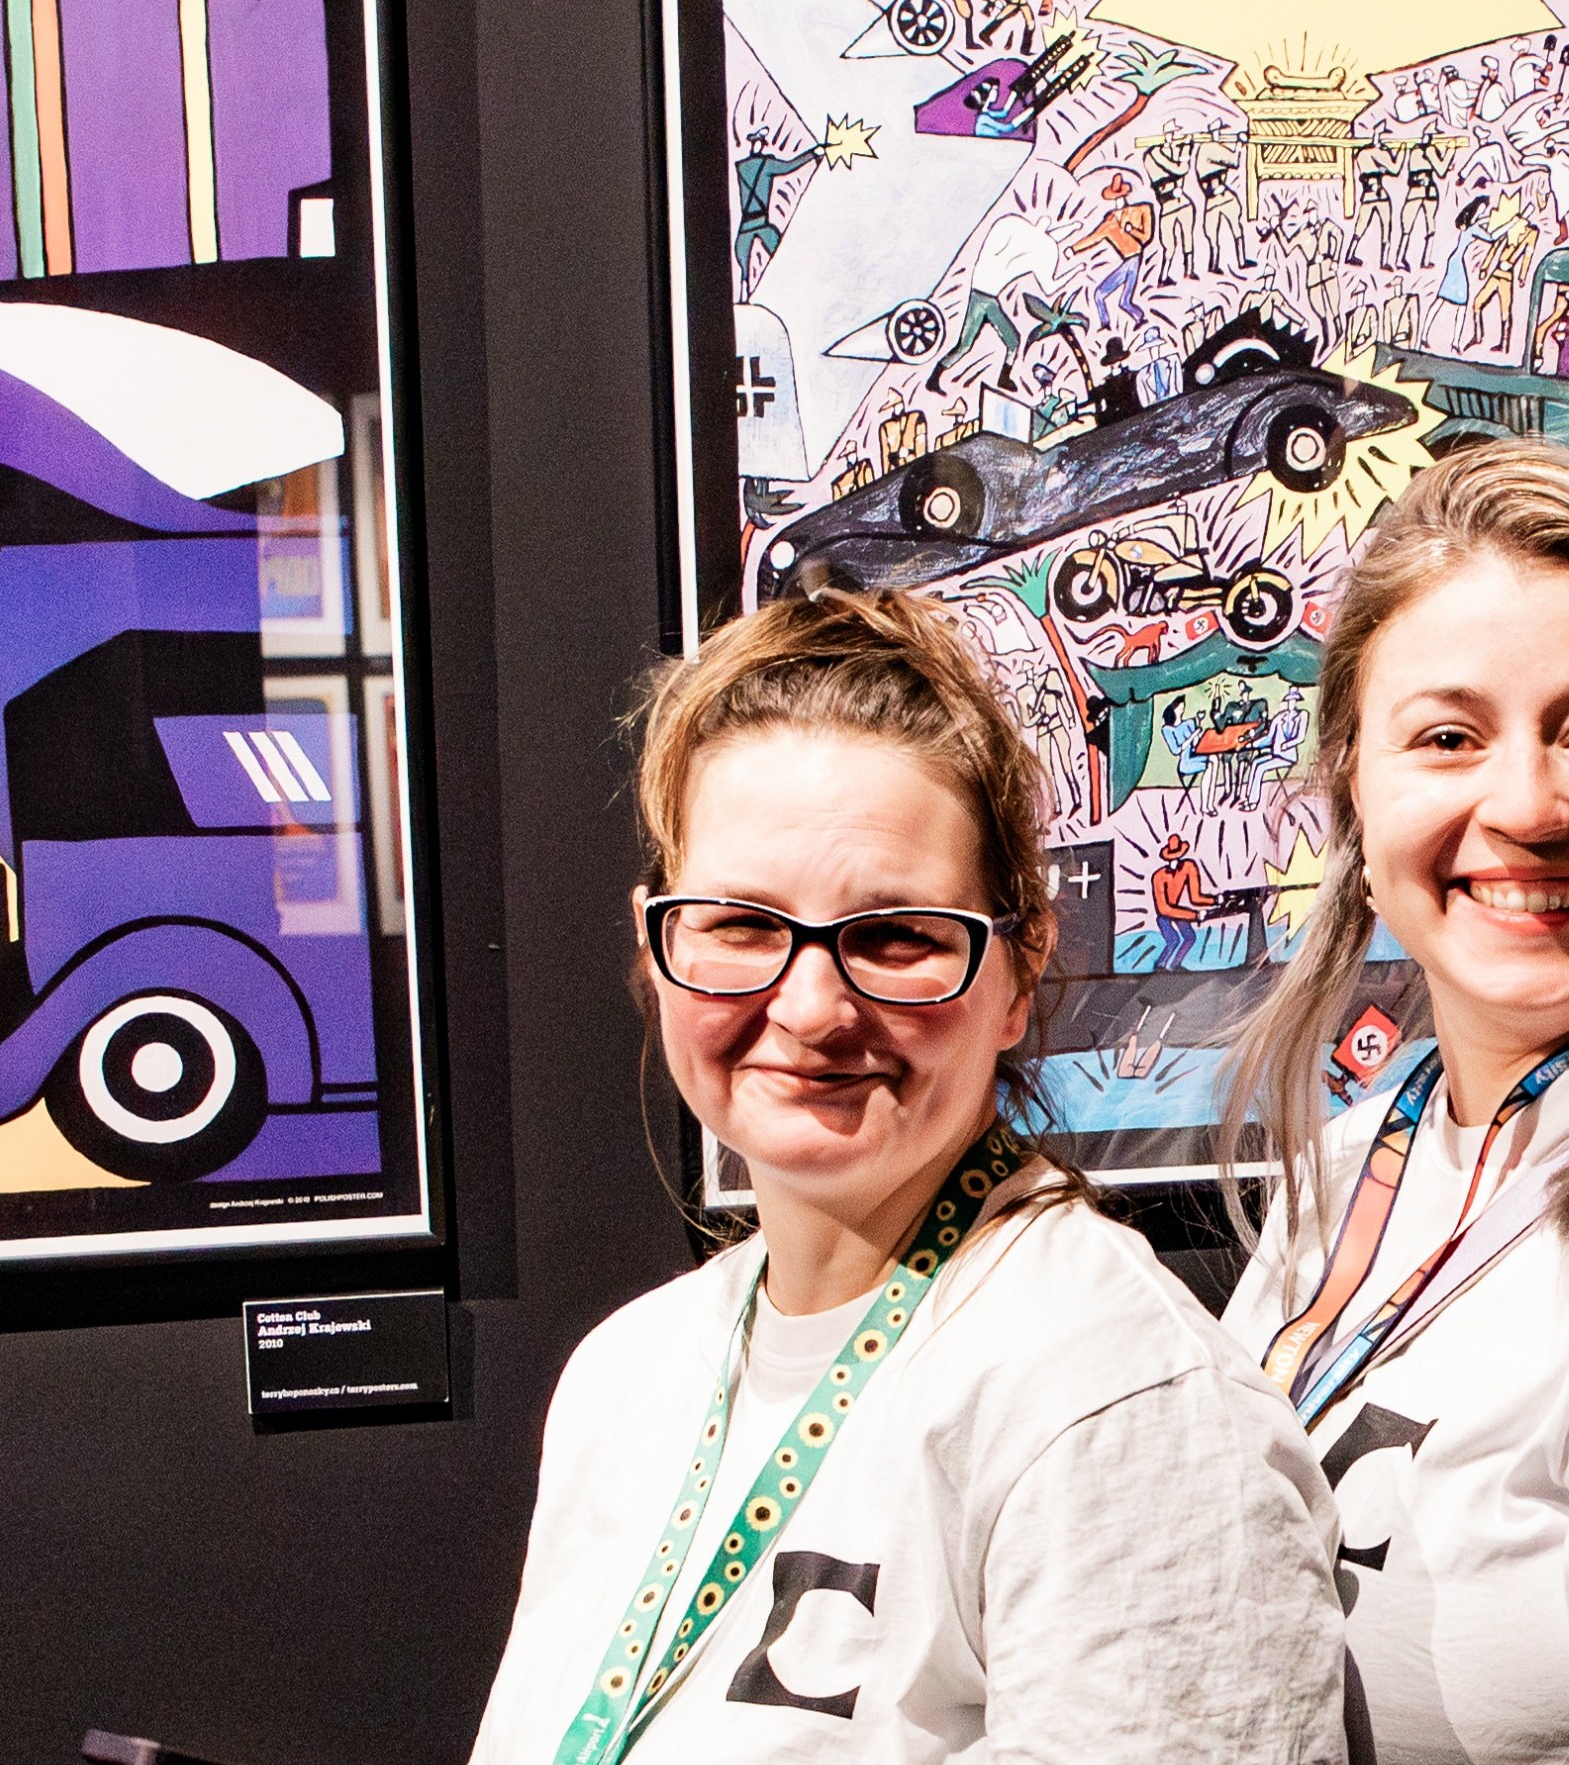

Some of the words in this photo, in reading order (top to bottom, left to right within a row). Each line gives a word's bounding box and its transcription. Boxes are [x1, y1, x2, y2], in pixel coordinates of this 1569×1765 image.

[257, 1313, 293, 1324] Cotton
[295, 1310, 321, 1321] Club
[257, 1322, 306, 1337] Andrzej
[308, 1319, 372, 1335] Krajewski
[258, 1339, 284, 1349] 2010
[1270, 1321, 1322, 1384] NEWTON
[1299, 1346, 1361, 1421] niversity
[576, 1727, 602, 1764] Airport
